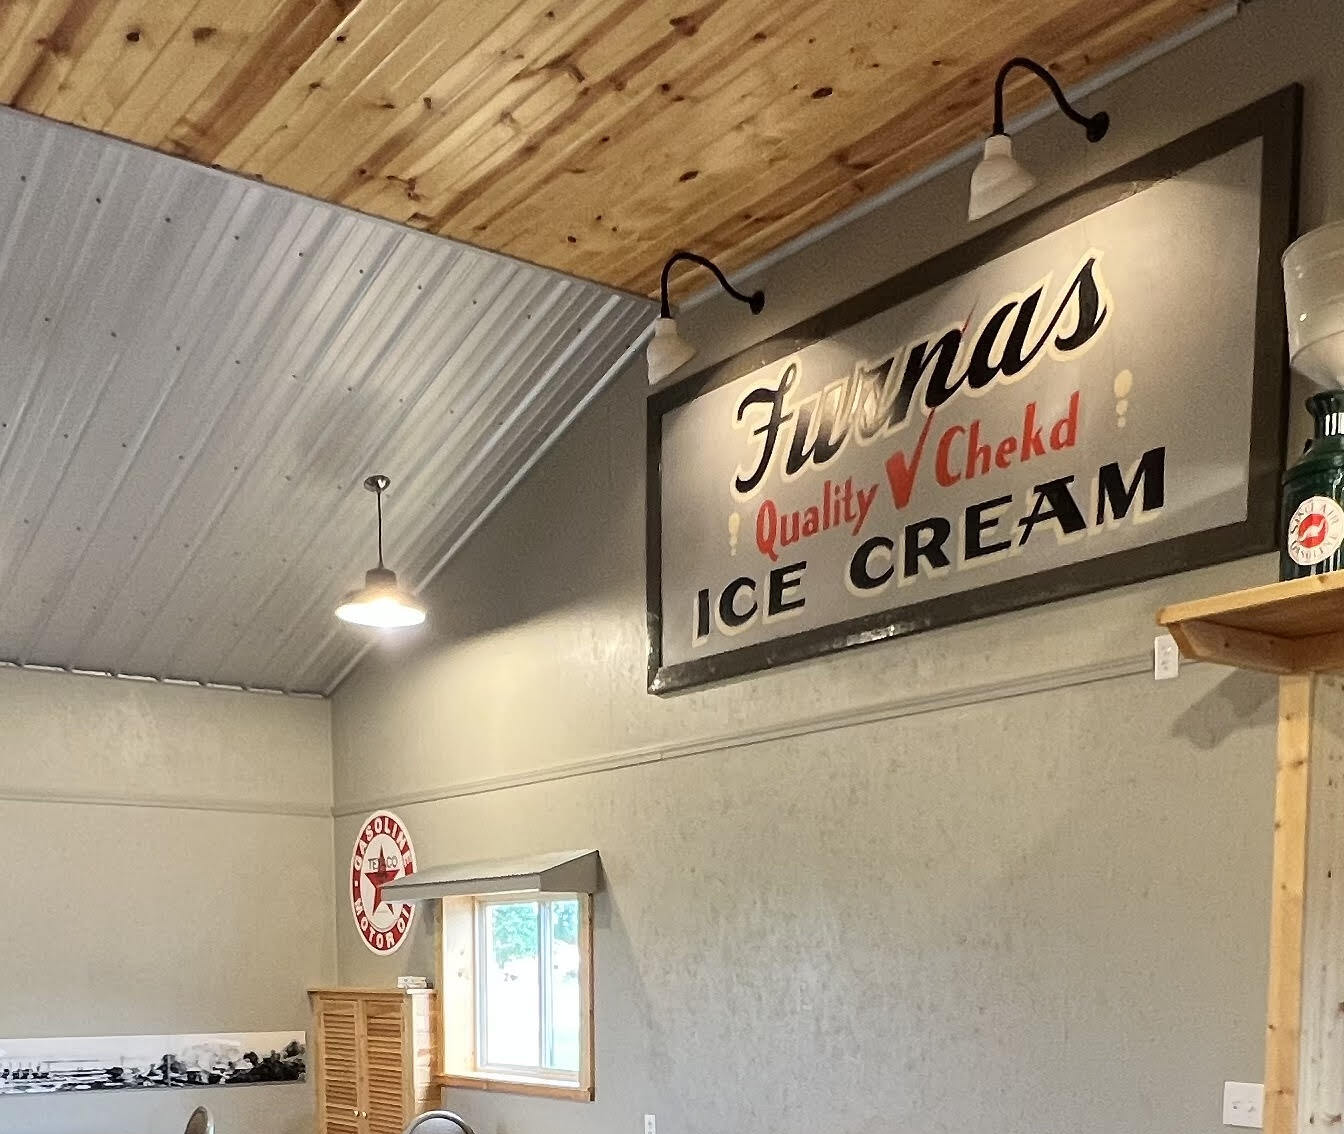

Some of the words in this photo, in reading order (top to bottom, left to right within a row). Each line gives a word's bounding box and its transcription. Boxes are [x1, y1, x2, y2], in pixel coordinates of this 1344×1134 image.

[734, 256, 1109, 496] Furnas
[694, 559, 808, 640] ICE
[849, 446, 1166, 591] CREAM
[755, 475, 880, 562] Quality
[934, 390, 1081, 489] Chekd
[354, 816, 413, 872] GASOLINE
[354, 897, 396, 950] MOTOR
[396, 902, 413, 934] OI
